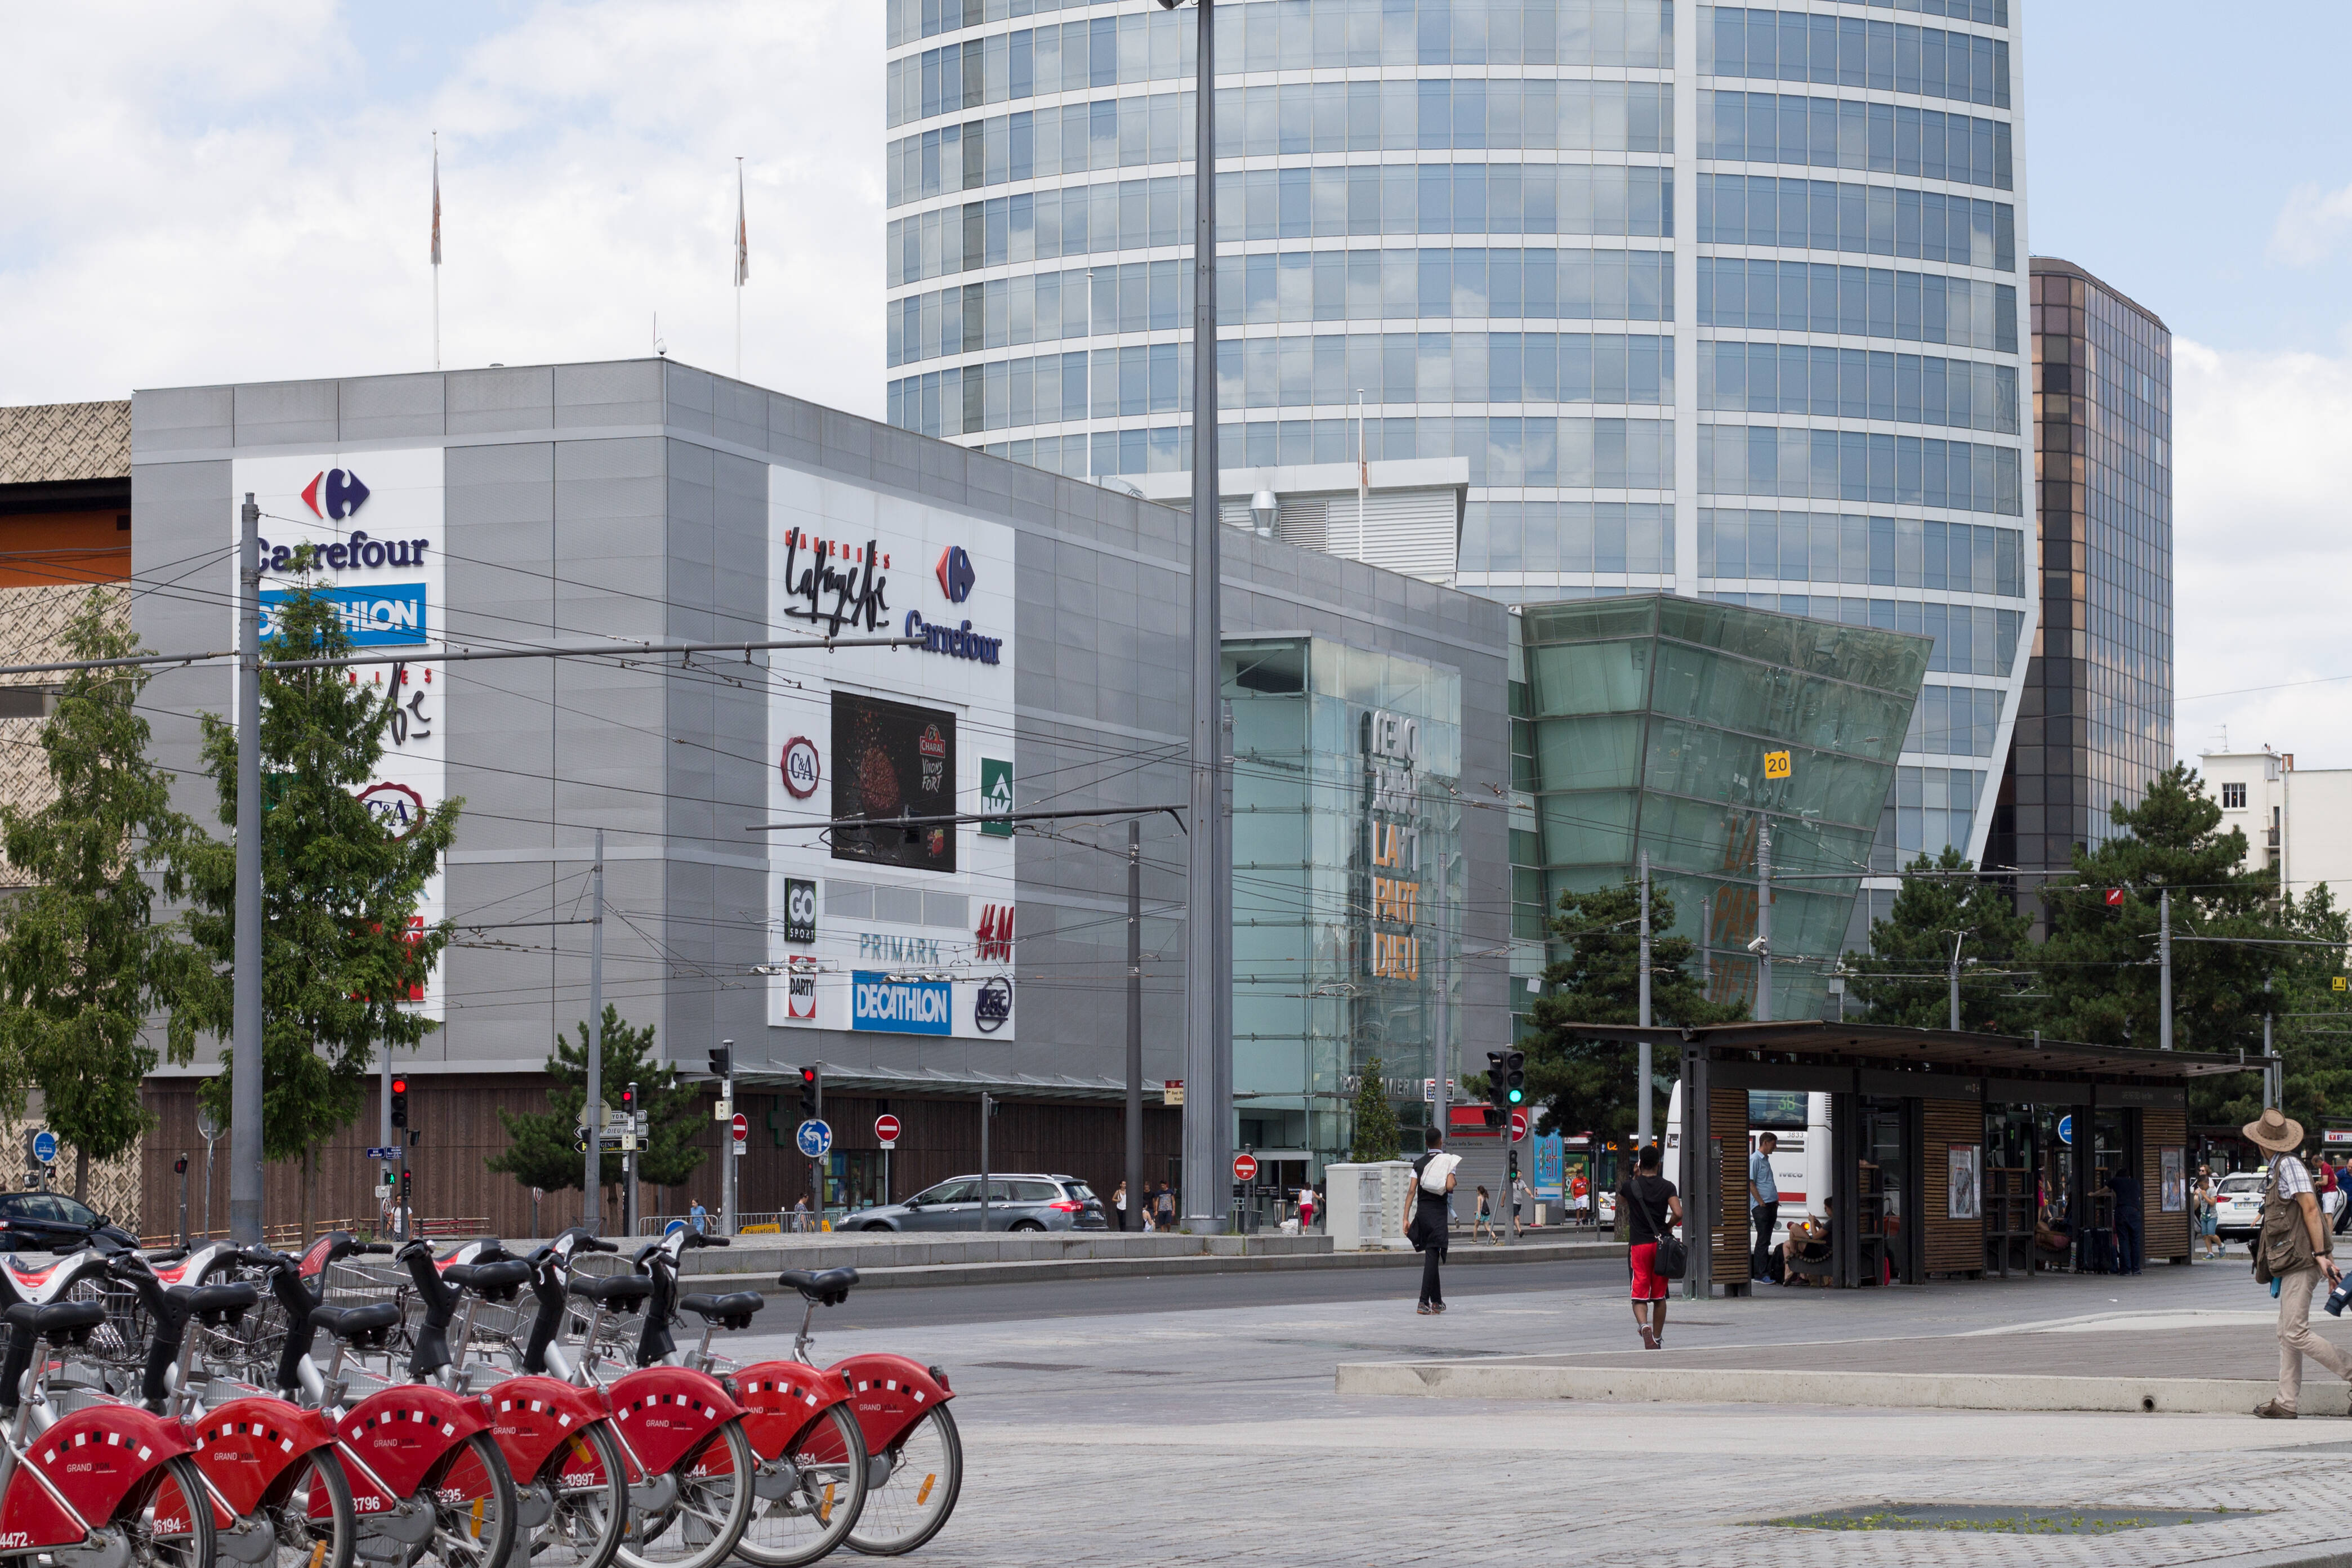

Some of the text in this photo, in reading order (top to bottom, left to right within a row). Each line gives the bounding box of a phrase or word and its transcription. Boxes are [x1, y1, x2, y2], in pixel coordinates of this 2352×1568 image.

[905, 610, 1002, 665] Carrefour
[922, 739, 944, 753] CHARAL
[791, 752, 814, 781] C&A
[1768, 757, 1787, 772] 20
[789, 888, 815, 923] GO
[1373, 876, 1420, 926] PART
[1709, 886, 1777, 945] PAR
[789, 928, 814, 939] SPORT
[975, 904, 1014, 963] H&M
[859, 933, 939, 964] PRIMARK
[1373, 932, 1420, 981] DIEU
[789, 977, 815, 997] DARTY
[856, 983, 947, 1023] DECATHLON
[978, 989, 1007, 1017] UGC
[1778, 1095, 1795, 1110] 38
[0, 1532, 28, 1548] 4472
[153, 1517, 180, 1534] 16194
